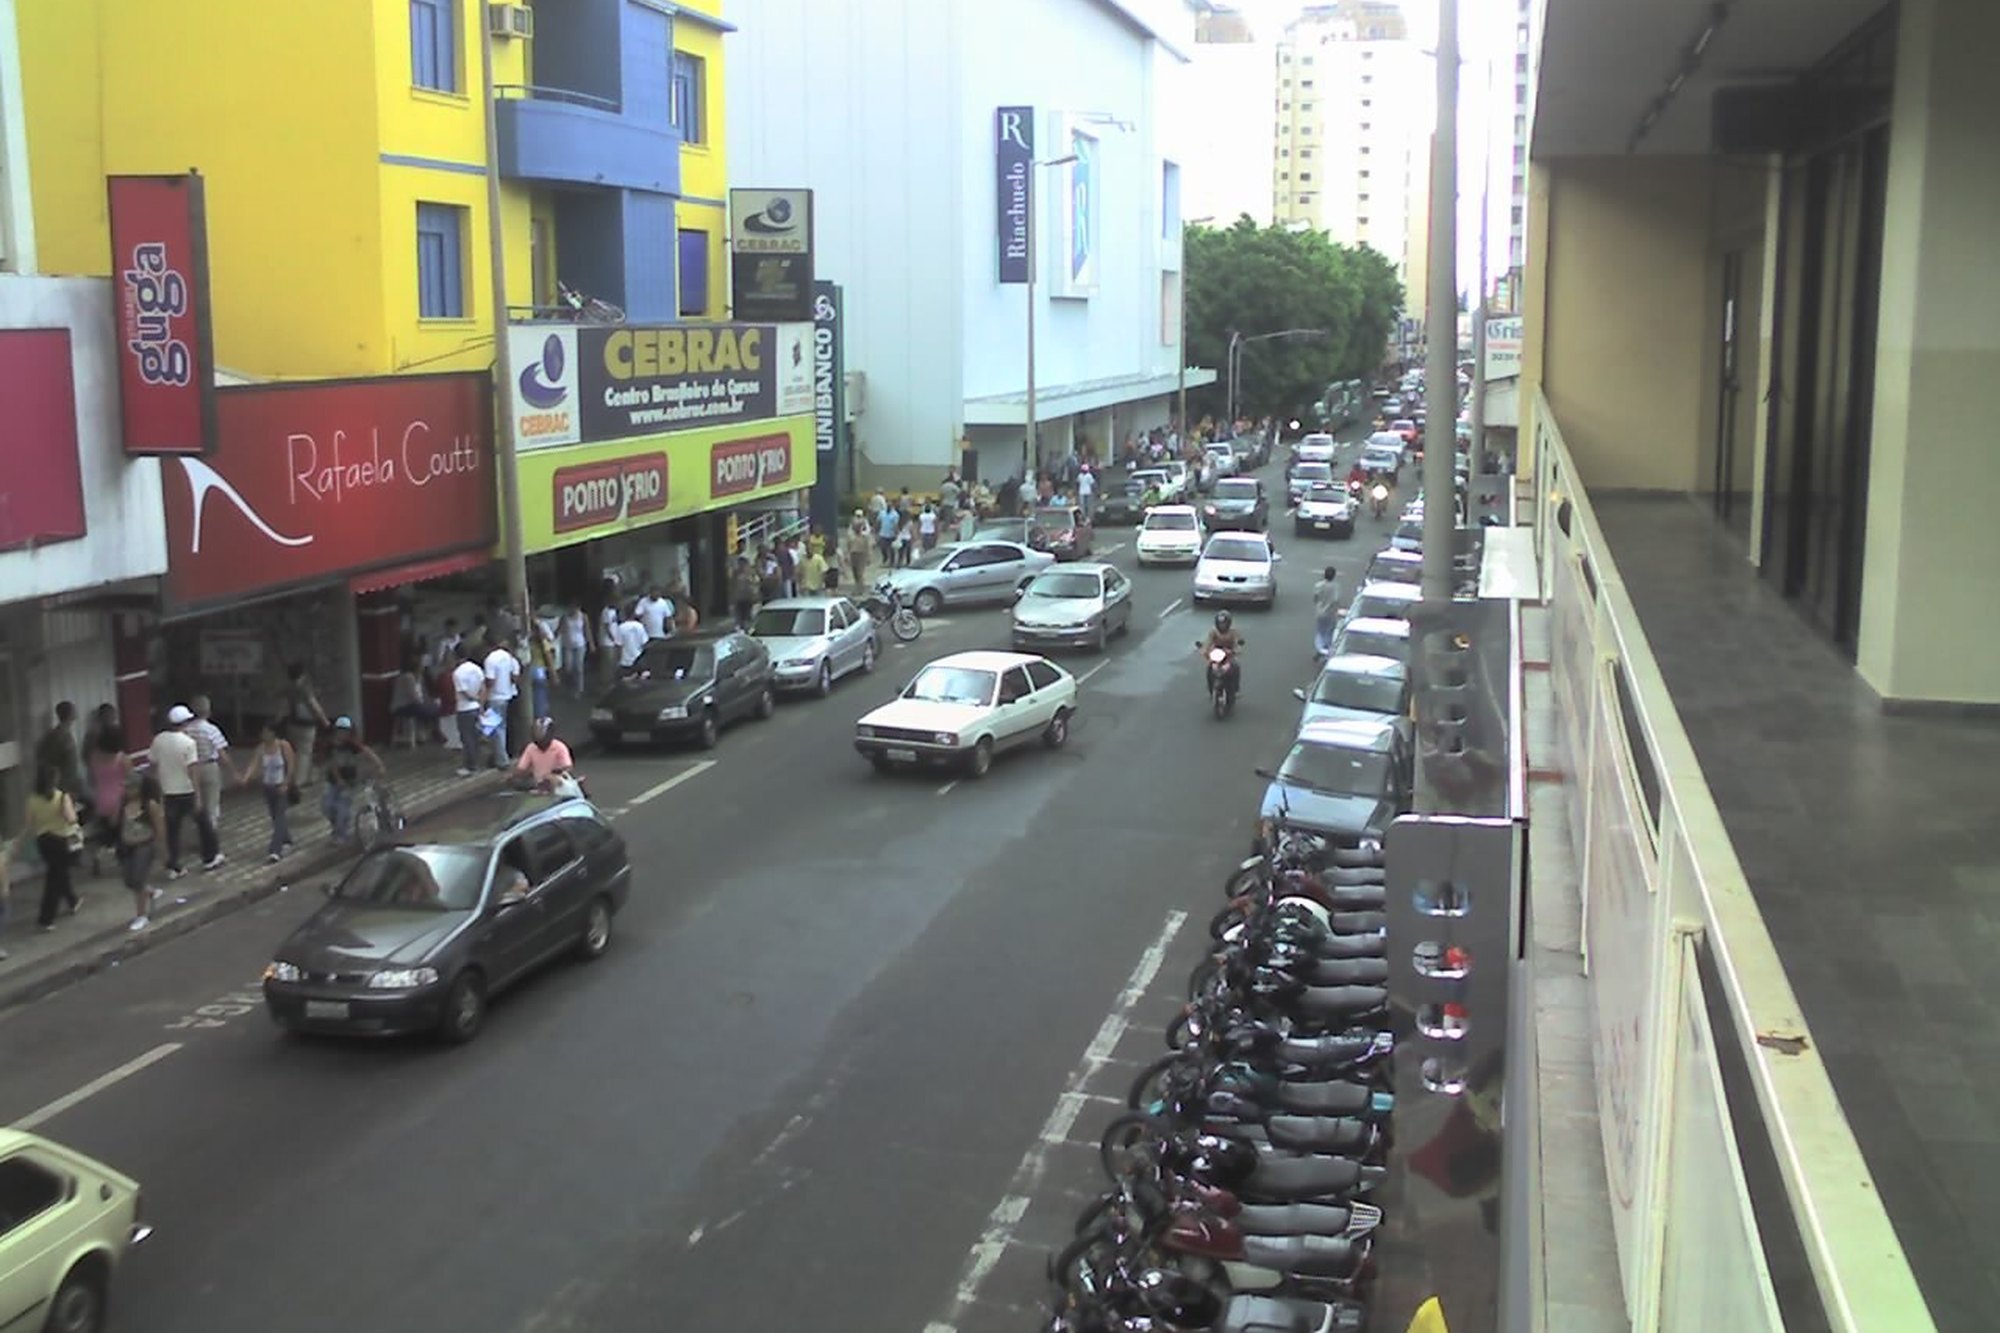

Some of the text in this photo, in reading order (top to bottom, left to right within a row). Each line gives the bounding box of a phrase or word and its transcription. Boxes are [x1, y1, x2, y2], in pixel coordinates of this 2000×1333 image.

[1001, 112, 1031, 150] R
[1006, 161, 1026, 258] Riachuelo
[737, 239, 802, 251] CEBRAC
[124, 242, 191, 387] guga
[604, 328, 761, 380] CEBRAC
[604, 387, 649, 407] Centro
[652, 381, 710, 402] Brasileiro
[728, 378, 760, 399] Cursos
[815, 327, 834, 451] UNIBANCO
[521, 412, 570, 437] CEBRAC
[288, 428, 395, 504] Rafaela
[717, 447, 786, 485] PONTO FRIO
[563, 470, 661, 516] PONTO FRIO
